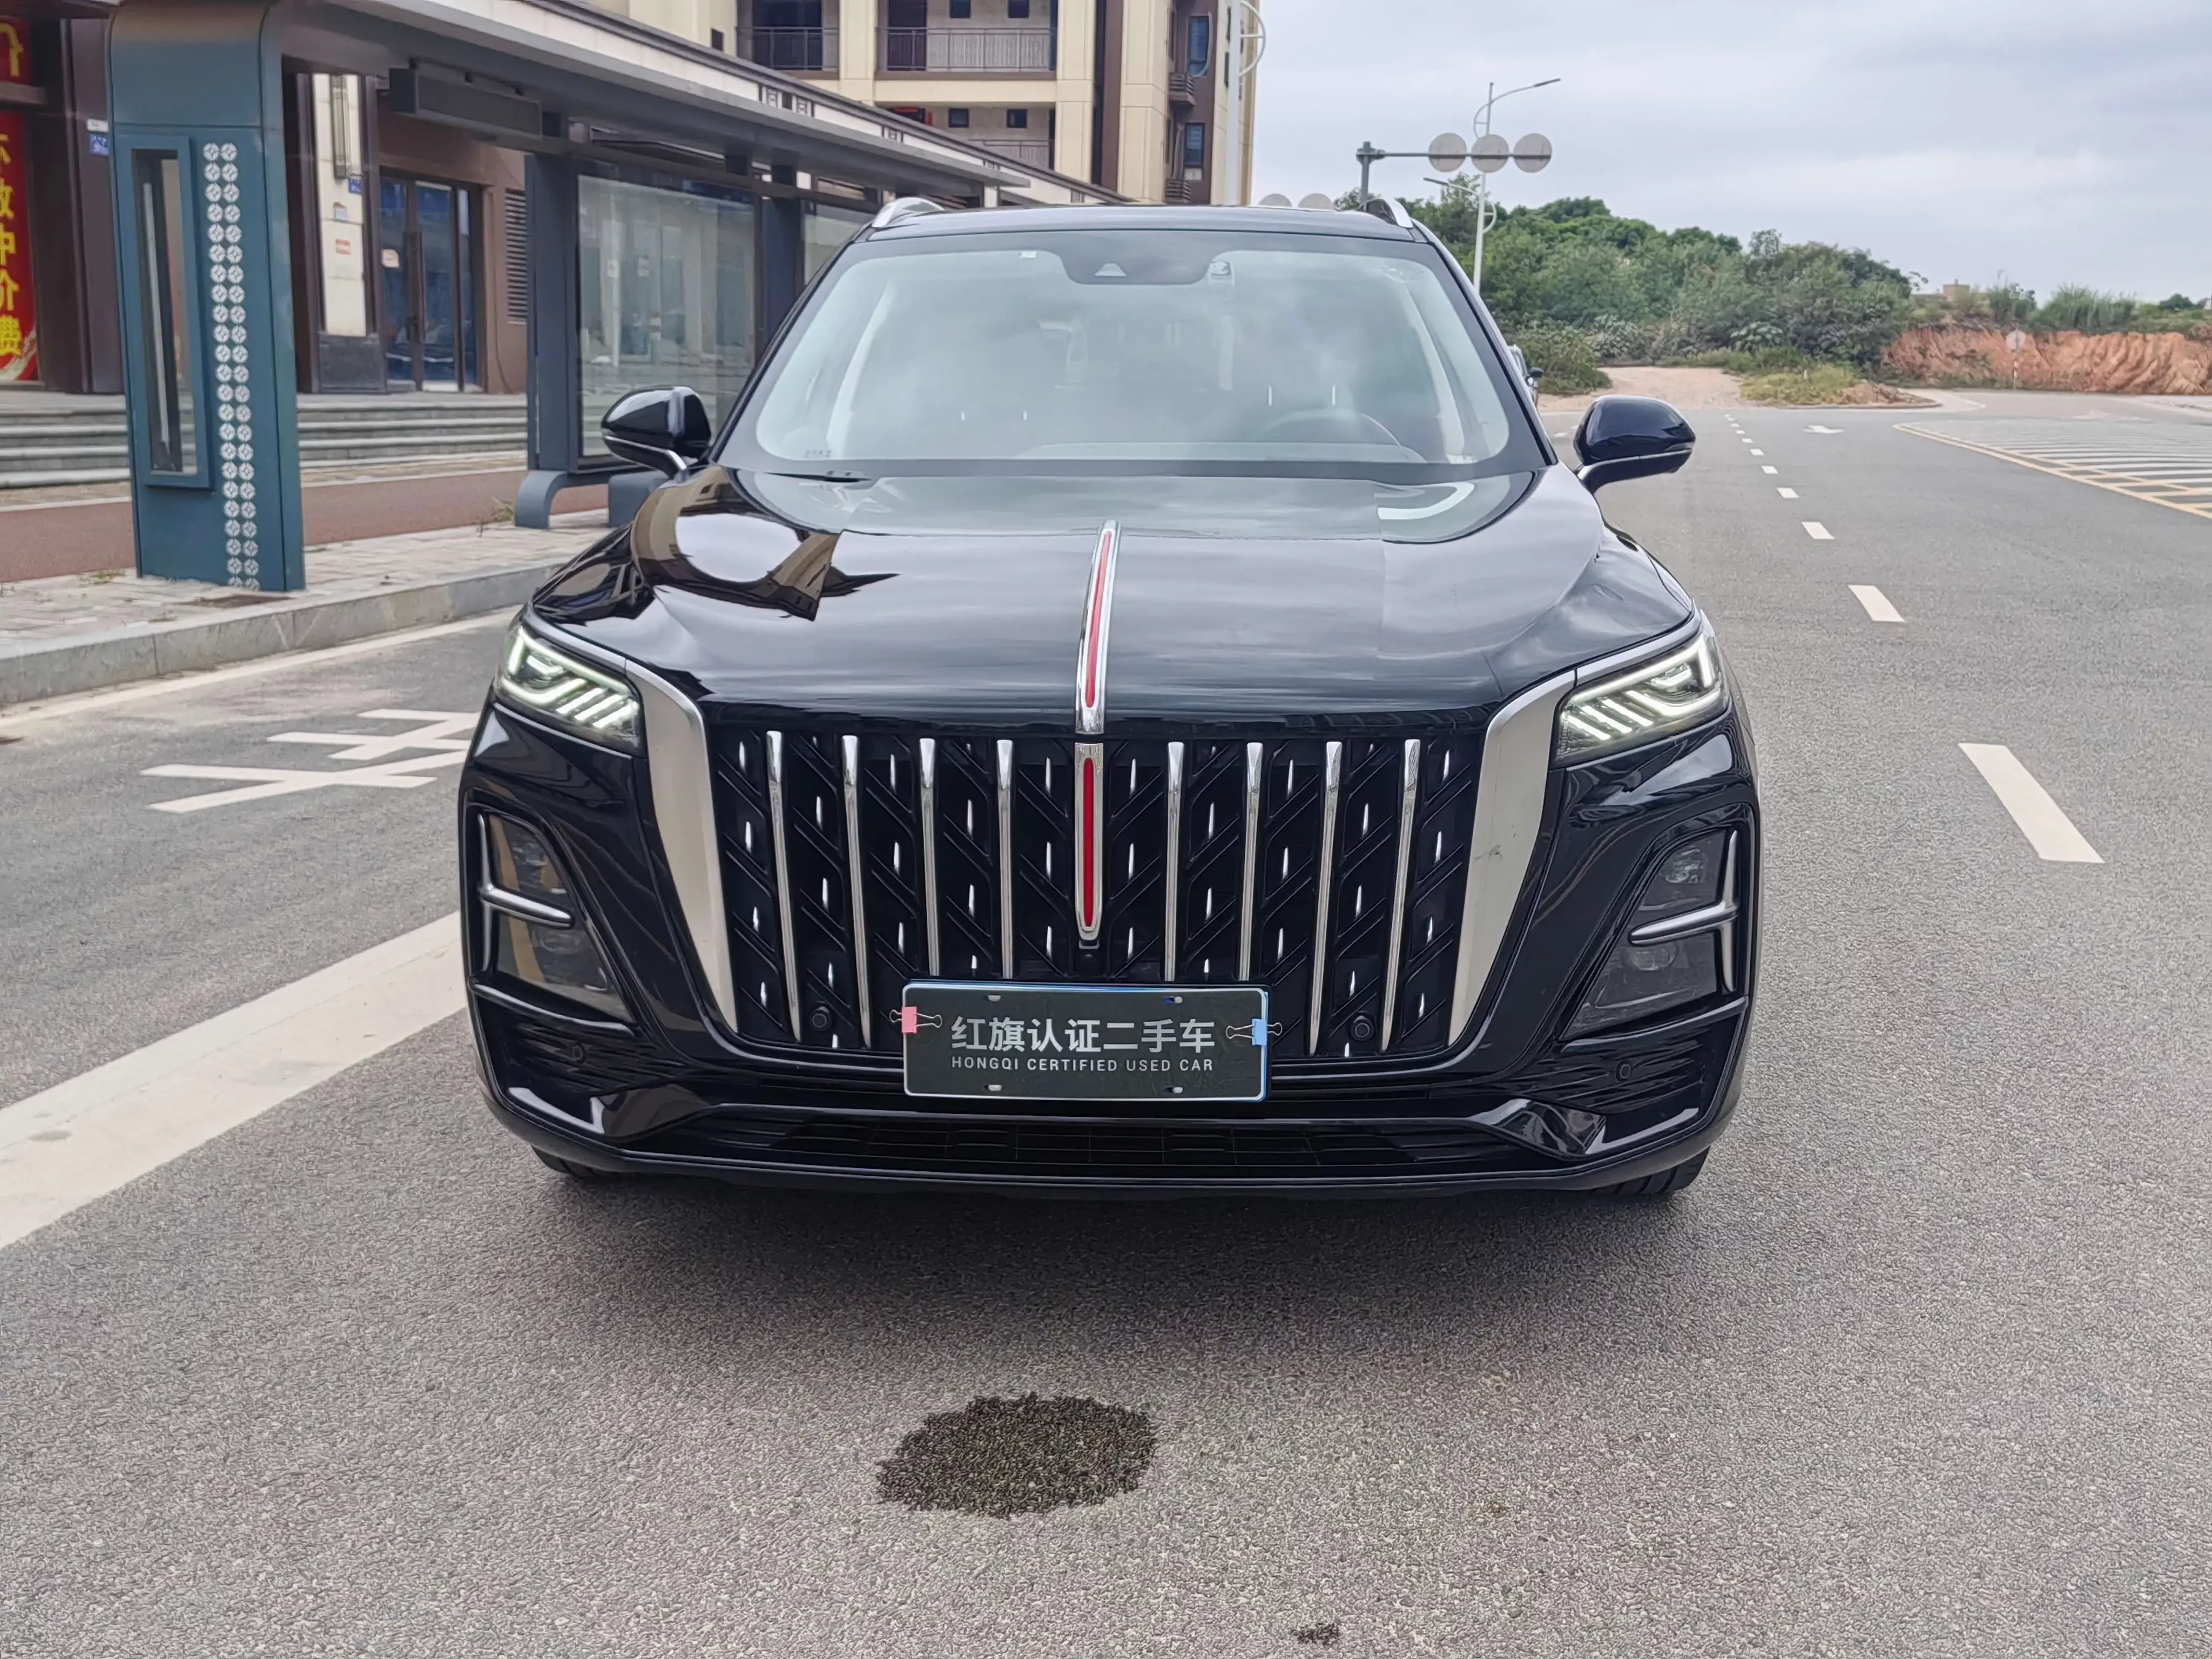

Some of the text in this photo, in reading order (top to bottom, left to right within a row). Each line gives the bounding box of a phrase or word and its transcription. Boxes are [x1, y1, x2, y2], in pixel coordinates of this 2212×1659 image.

[951, 1016, 1215, 1053] 红旗认证二手车
[952, 1056, 1212, 1071] HONGQI CERTIFIED USED CAR
